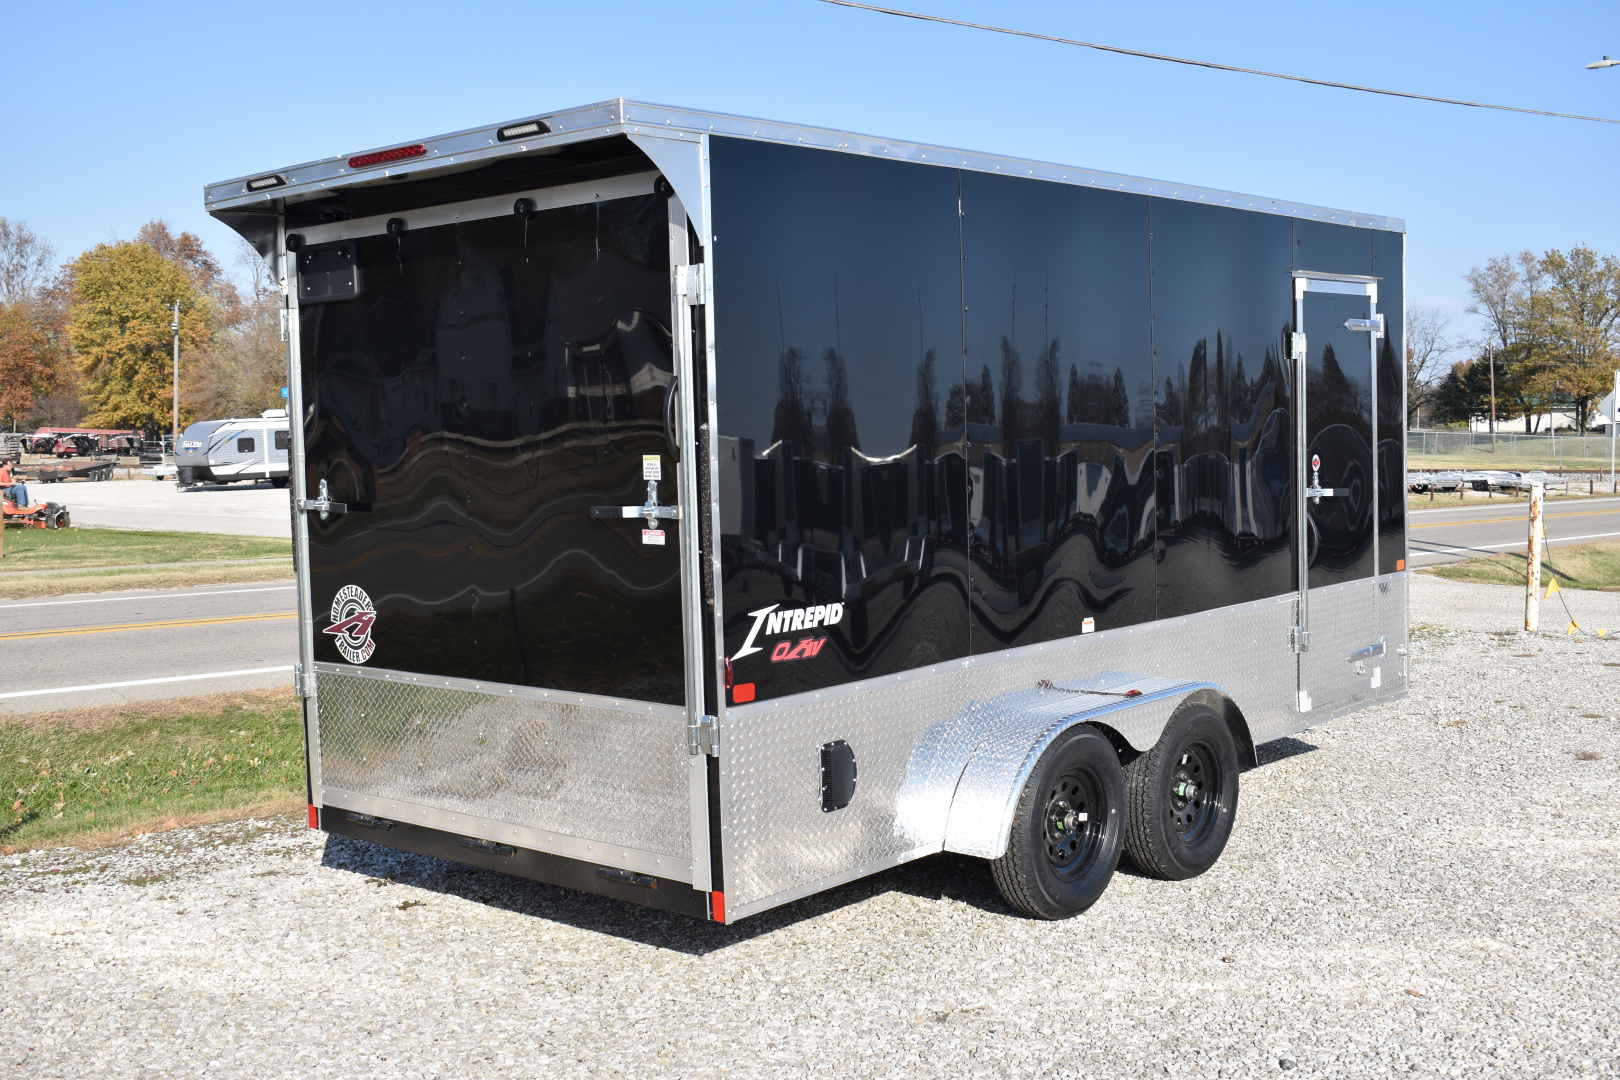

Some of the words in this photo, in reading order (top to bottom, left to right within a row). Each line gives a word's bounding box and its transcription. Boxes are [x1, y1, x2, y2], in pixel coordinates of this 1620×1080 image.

[182, 440, 202, 448] SALEM
[331, 585, 373, 622] HOMESTEADER
[730, 602, 844, 662] INTREPID
[335, 636, 375, 663] TRAILER.COM
